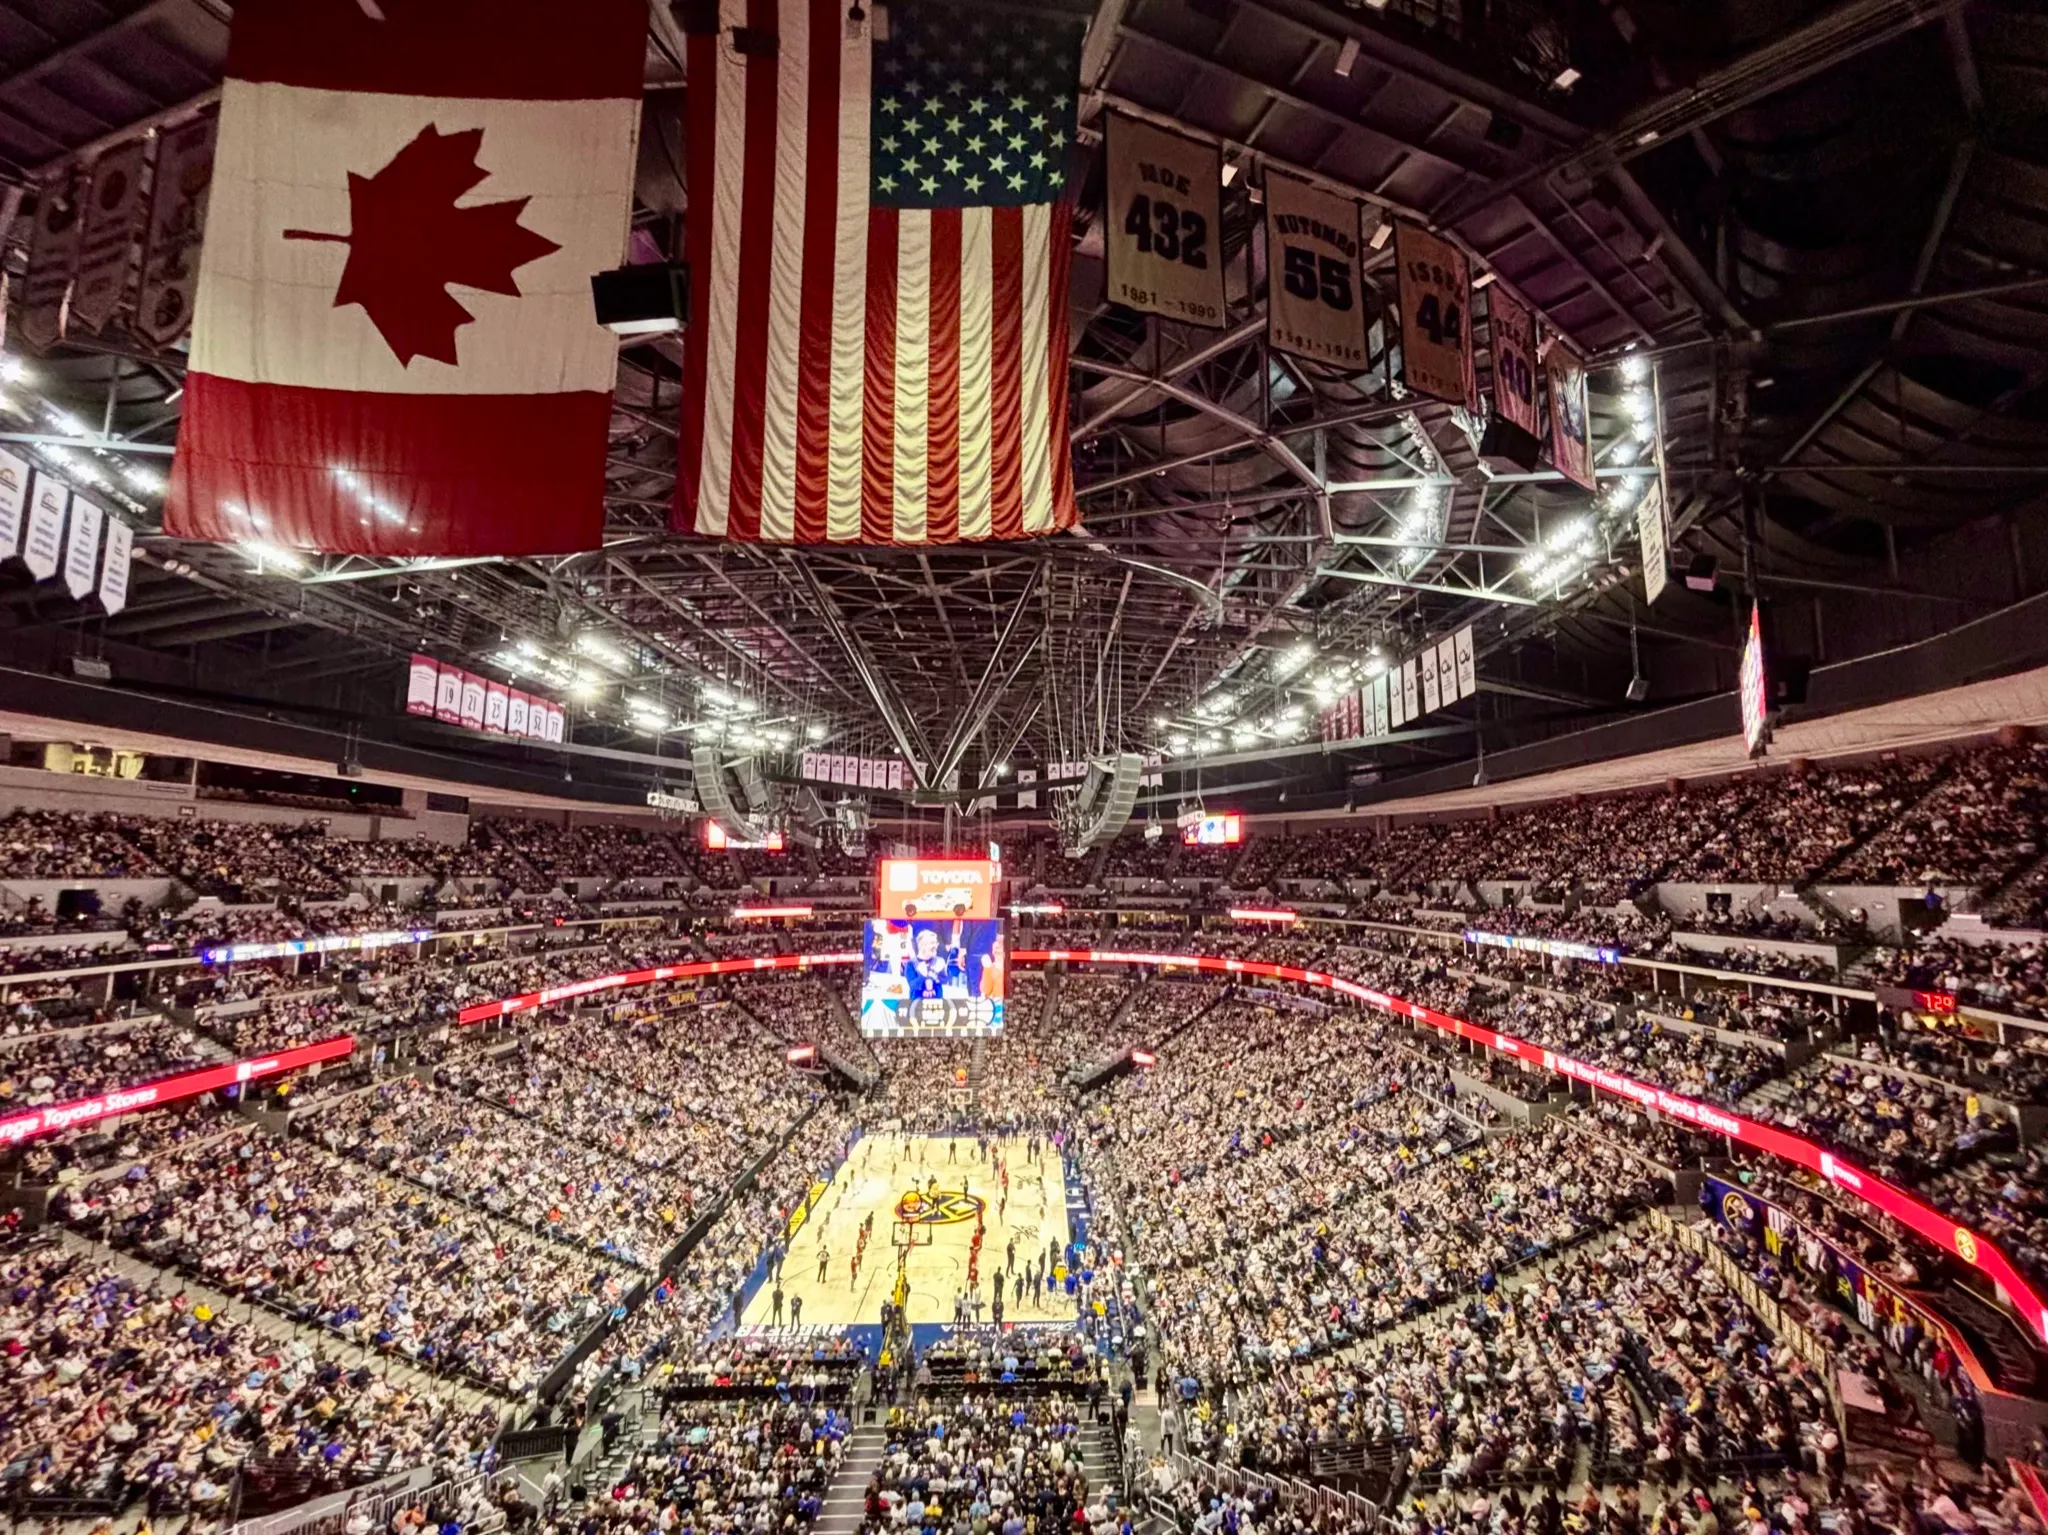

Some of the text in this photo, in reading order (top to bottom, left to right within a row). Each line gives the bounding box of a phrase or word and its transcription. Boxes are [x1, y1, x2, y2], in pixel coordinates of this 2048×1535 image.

[1138, 162, 1191, 196] MOE
[1125, 194, 1208, 270] 432
[1284, 243, 1354, 311] 55
[1121, 284, 1157, 306] 1981
[1180, 300, 1217, 320] 1990
[444, 685, 454, 704] 19
[468, 694, 477, 712] 21
[920, 869, 983, 885] TOYOTA
[43, 1101, 103, 1128] Toyota
[104, 1088, 158, 1112] Stores
[1596, 1069, 1622, 1090] Front
[1623, 1078, 1656, 1104] Range
[1657, 1091, 1696, 1118] Toyota
[1697, 1104, 1740, 1135] Stores
